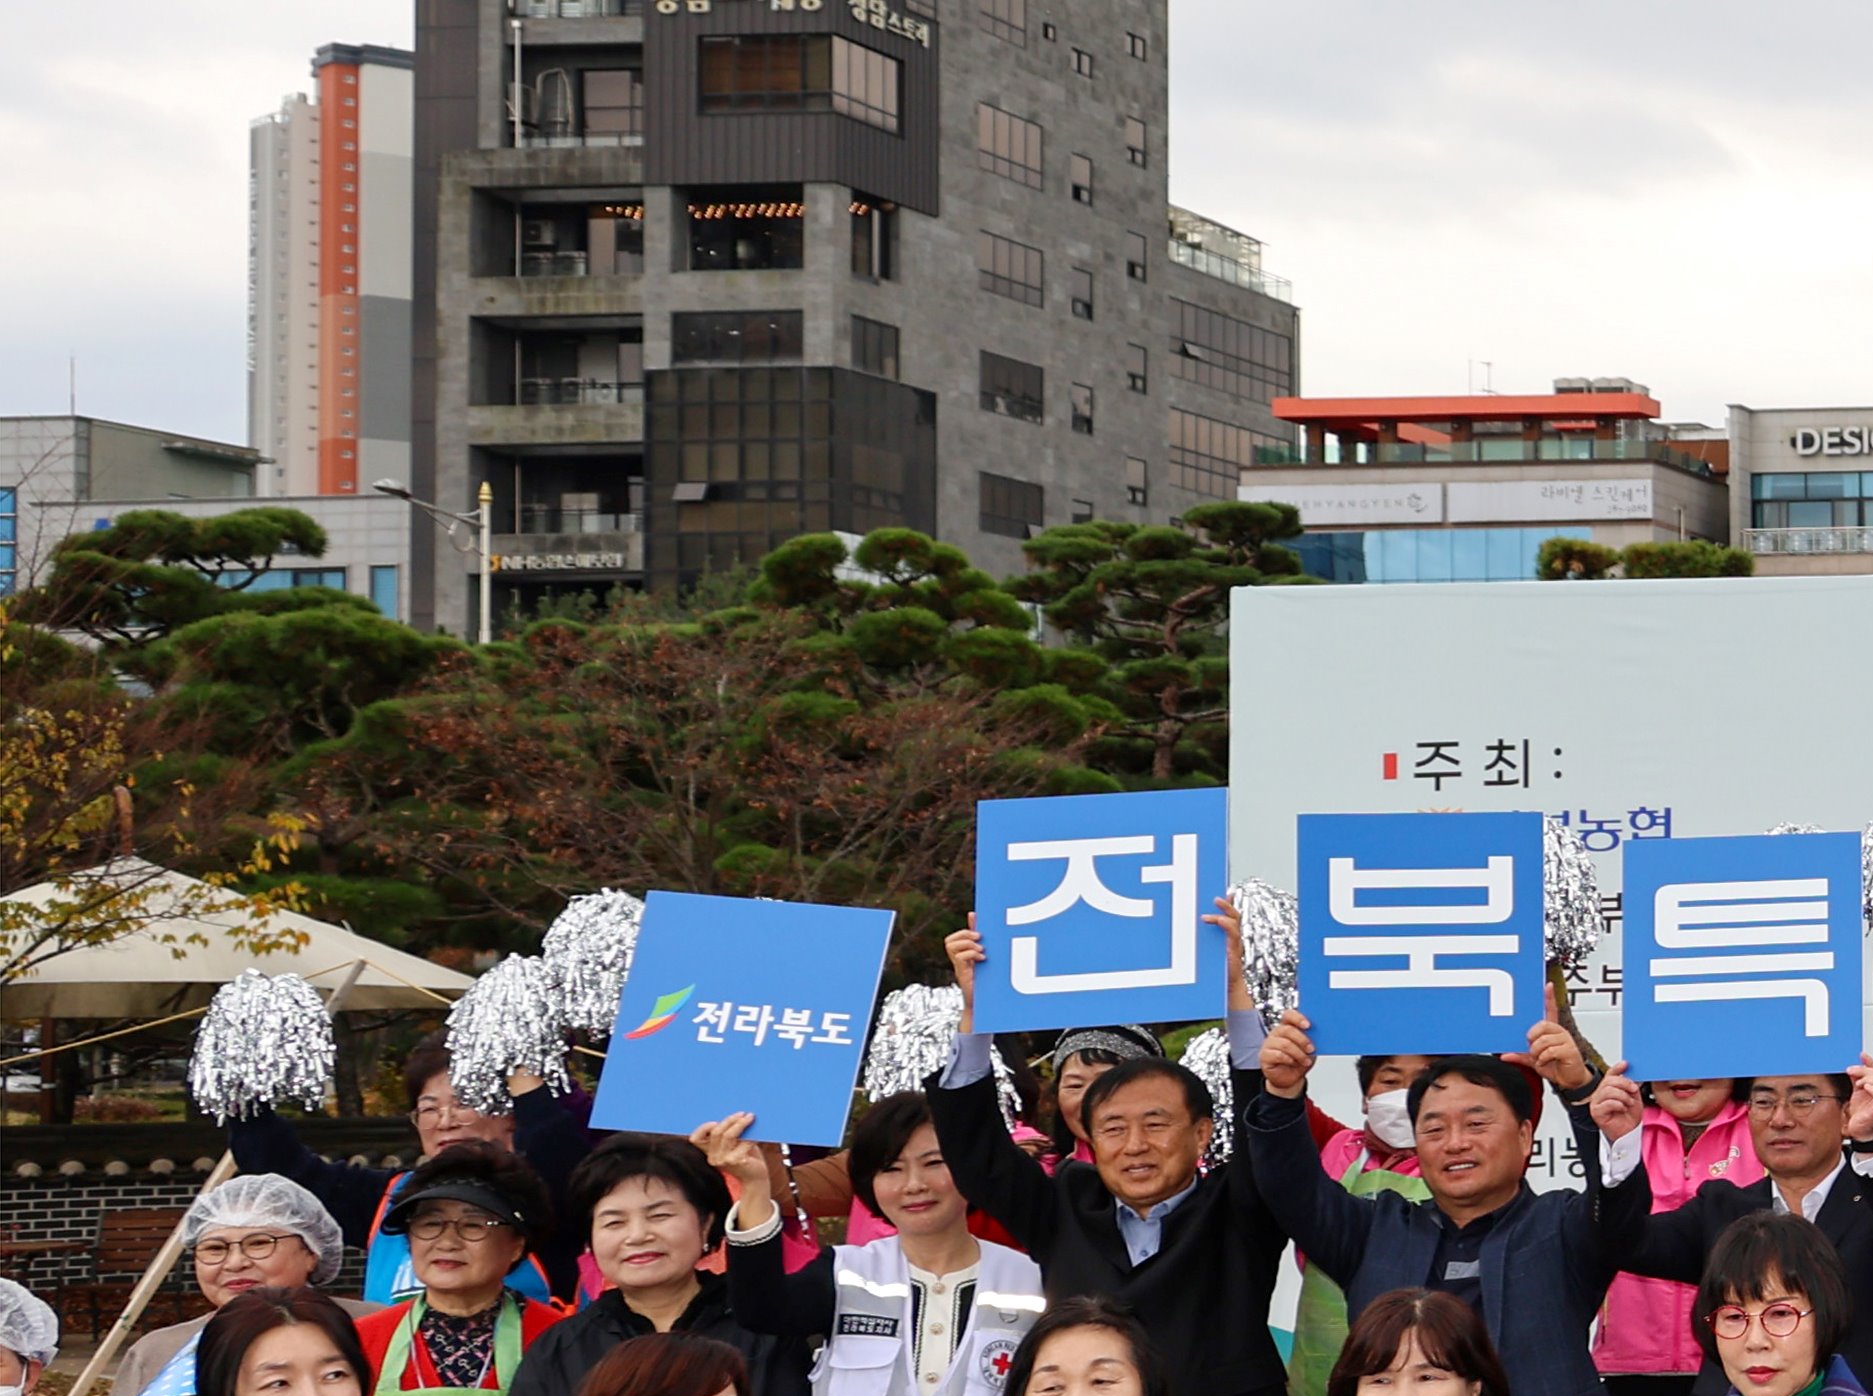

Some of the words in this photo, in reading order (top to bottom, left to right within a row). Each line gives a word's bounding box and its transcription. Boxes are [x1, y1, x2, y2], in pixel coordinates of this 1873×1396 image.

[1007, 834, 1196, 994] 전
[1325, 857, 1518, 1015] 북
[1651, 879, 1833, 1036] 특
[693, 1003, 851, 1048] 전라북도
